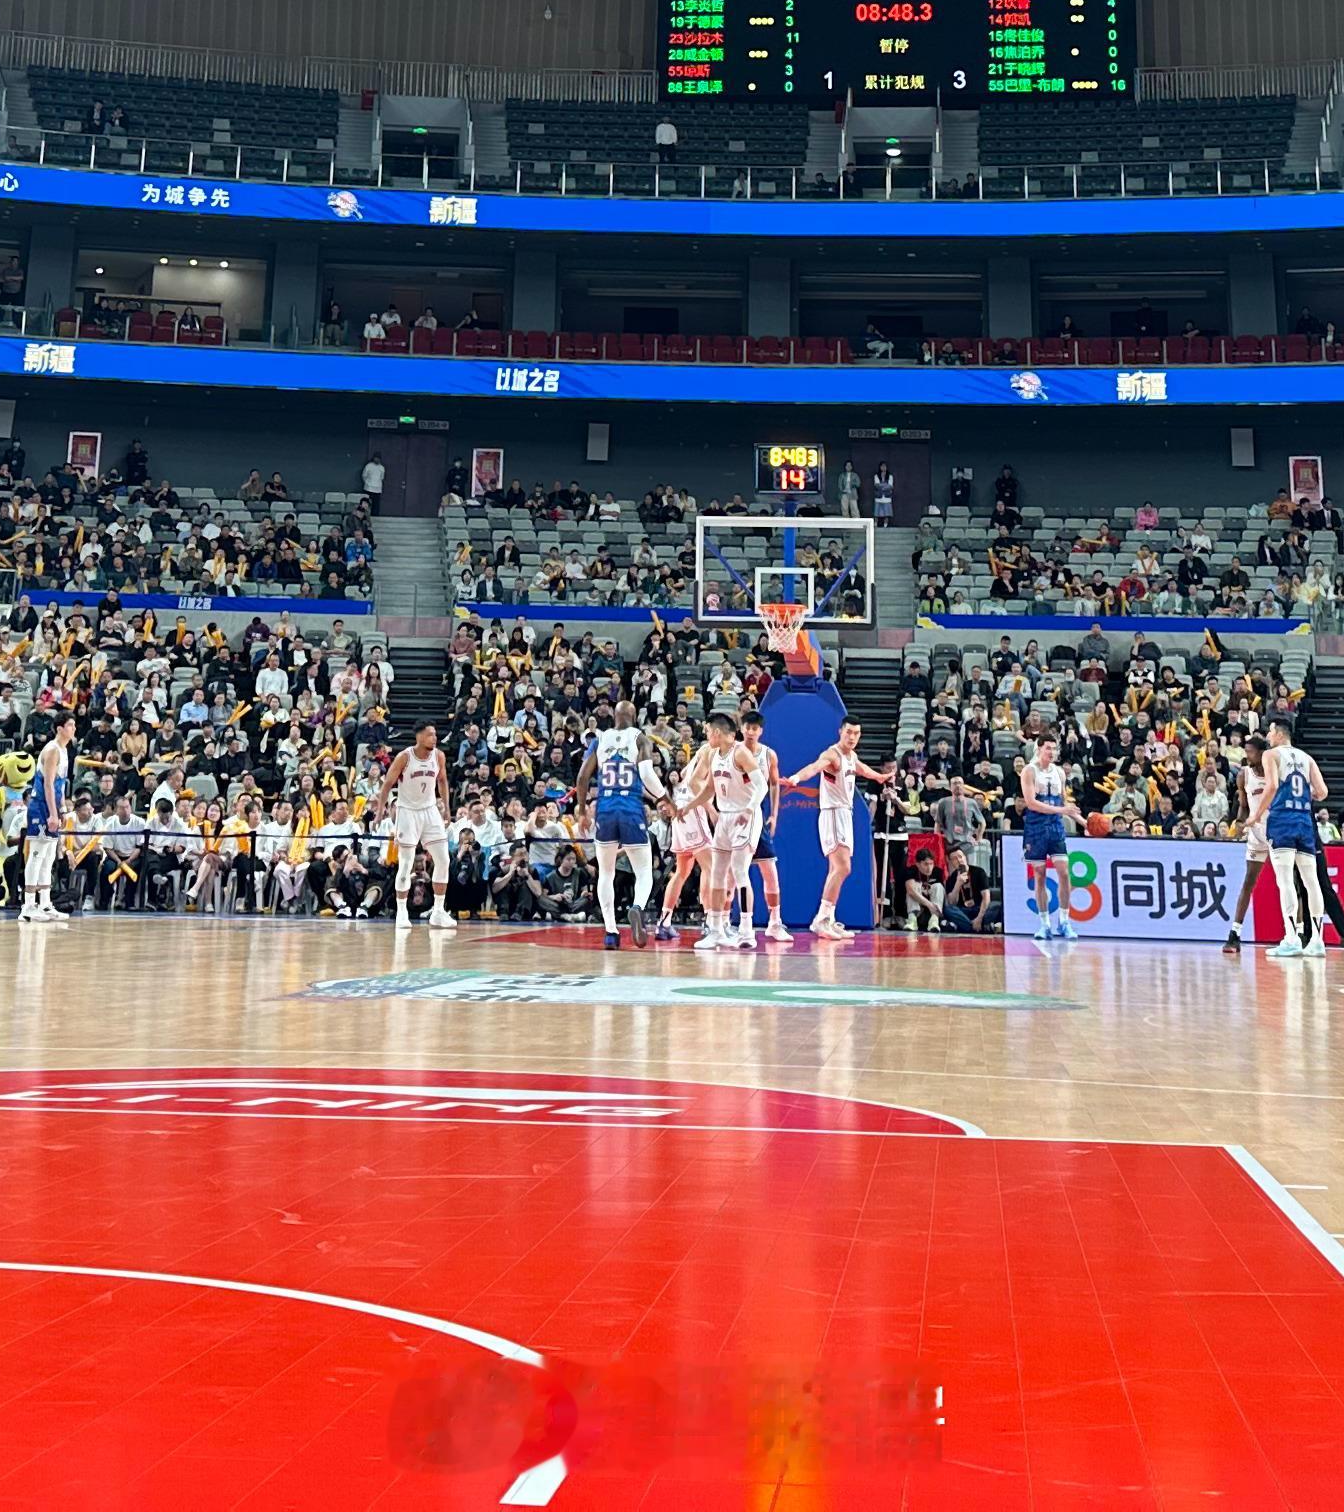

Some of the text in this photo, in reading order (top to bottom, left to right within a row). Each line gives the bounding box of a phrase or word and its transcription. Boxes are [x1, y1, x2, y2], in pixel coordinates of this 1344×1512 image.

[855, 2, 933, 22] 08:48.3
[879, 38, 909, 54] 暂停
[823, 69, 967, 90] 1 累计犯规 3
[142, 184, 229, 207] 为城争先
[429, 196, 477, 224] 新疆
[23, 342, 76, 373] 新疆
[496, 368, 559, 392] 以城之名
[1117, 371, 1167, 401] 新疆
[780, 469, 804, 490] 14
[602, 762, 634, 787] 55
[1291, 774, 1304, 798] 9
